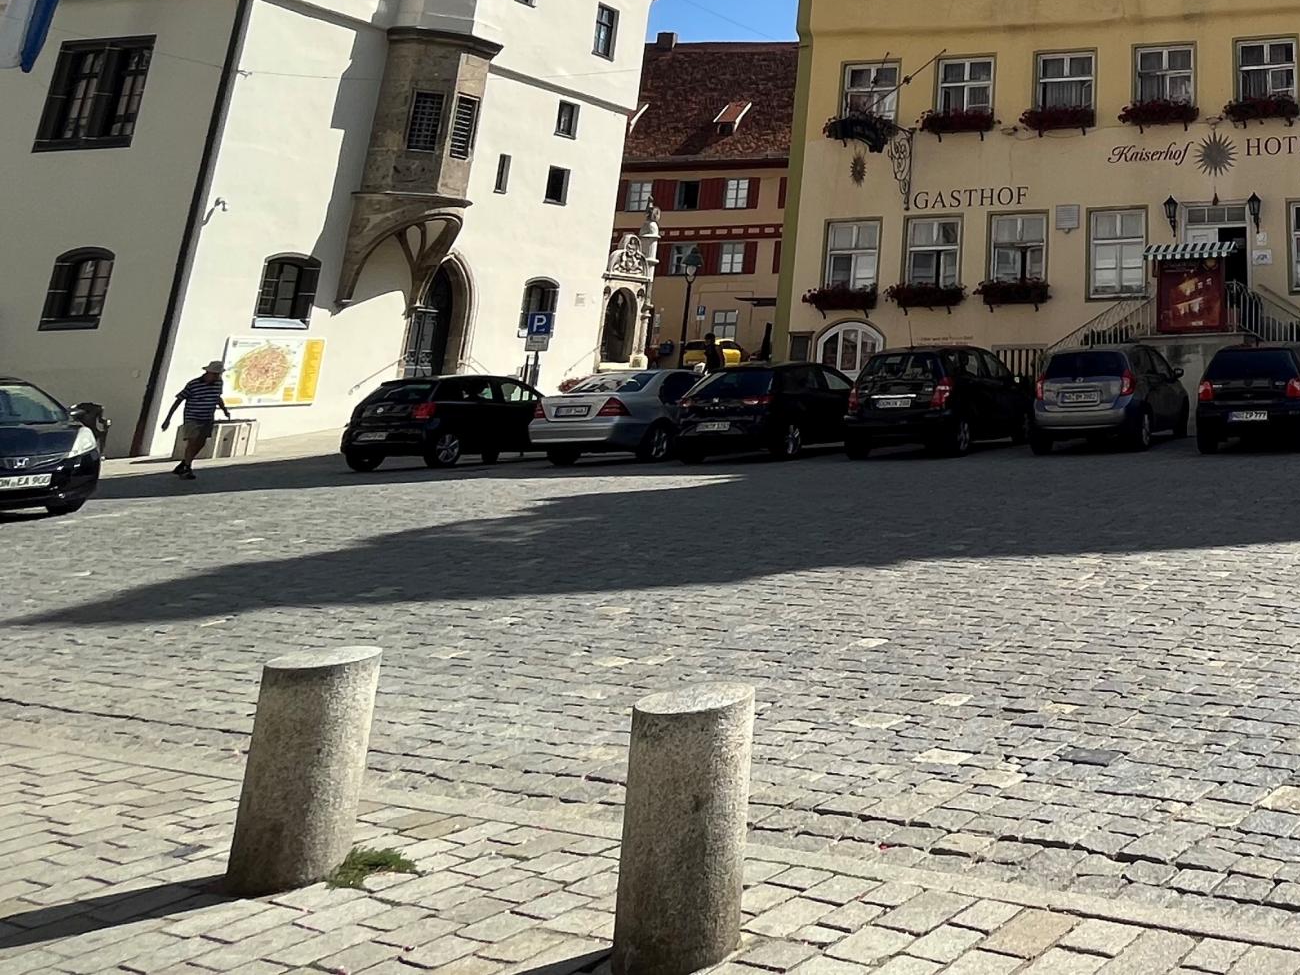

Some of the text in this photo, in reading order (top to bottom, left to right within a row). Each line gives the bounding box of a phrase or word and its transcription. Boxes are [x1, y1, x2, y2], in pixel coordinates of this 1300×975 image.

[1108, 141, 1194, 166] Kaiserhof
[913, 186, 1029, 210] GASTHOF
[533, 315, 547, 333] P
[17, 477, 30, 486] EA
